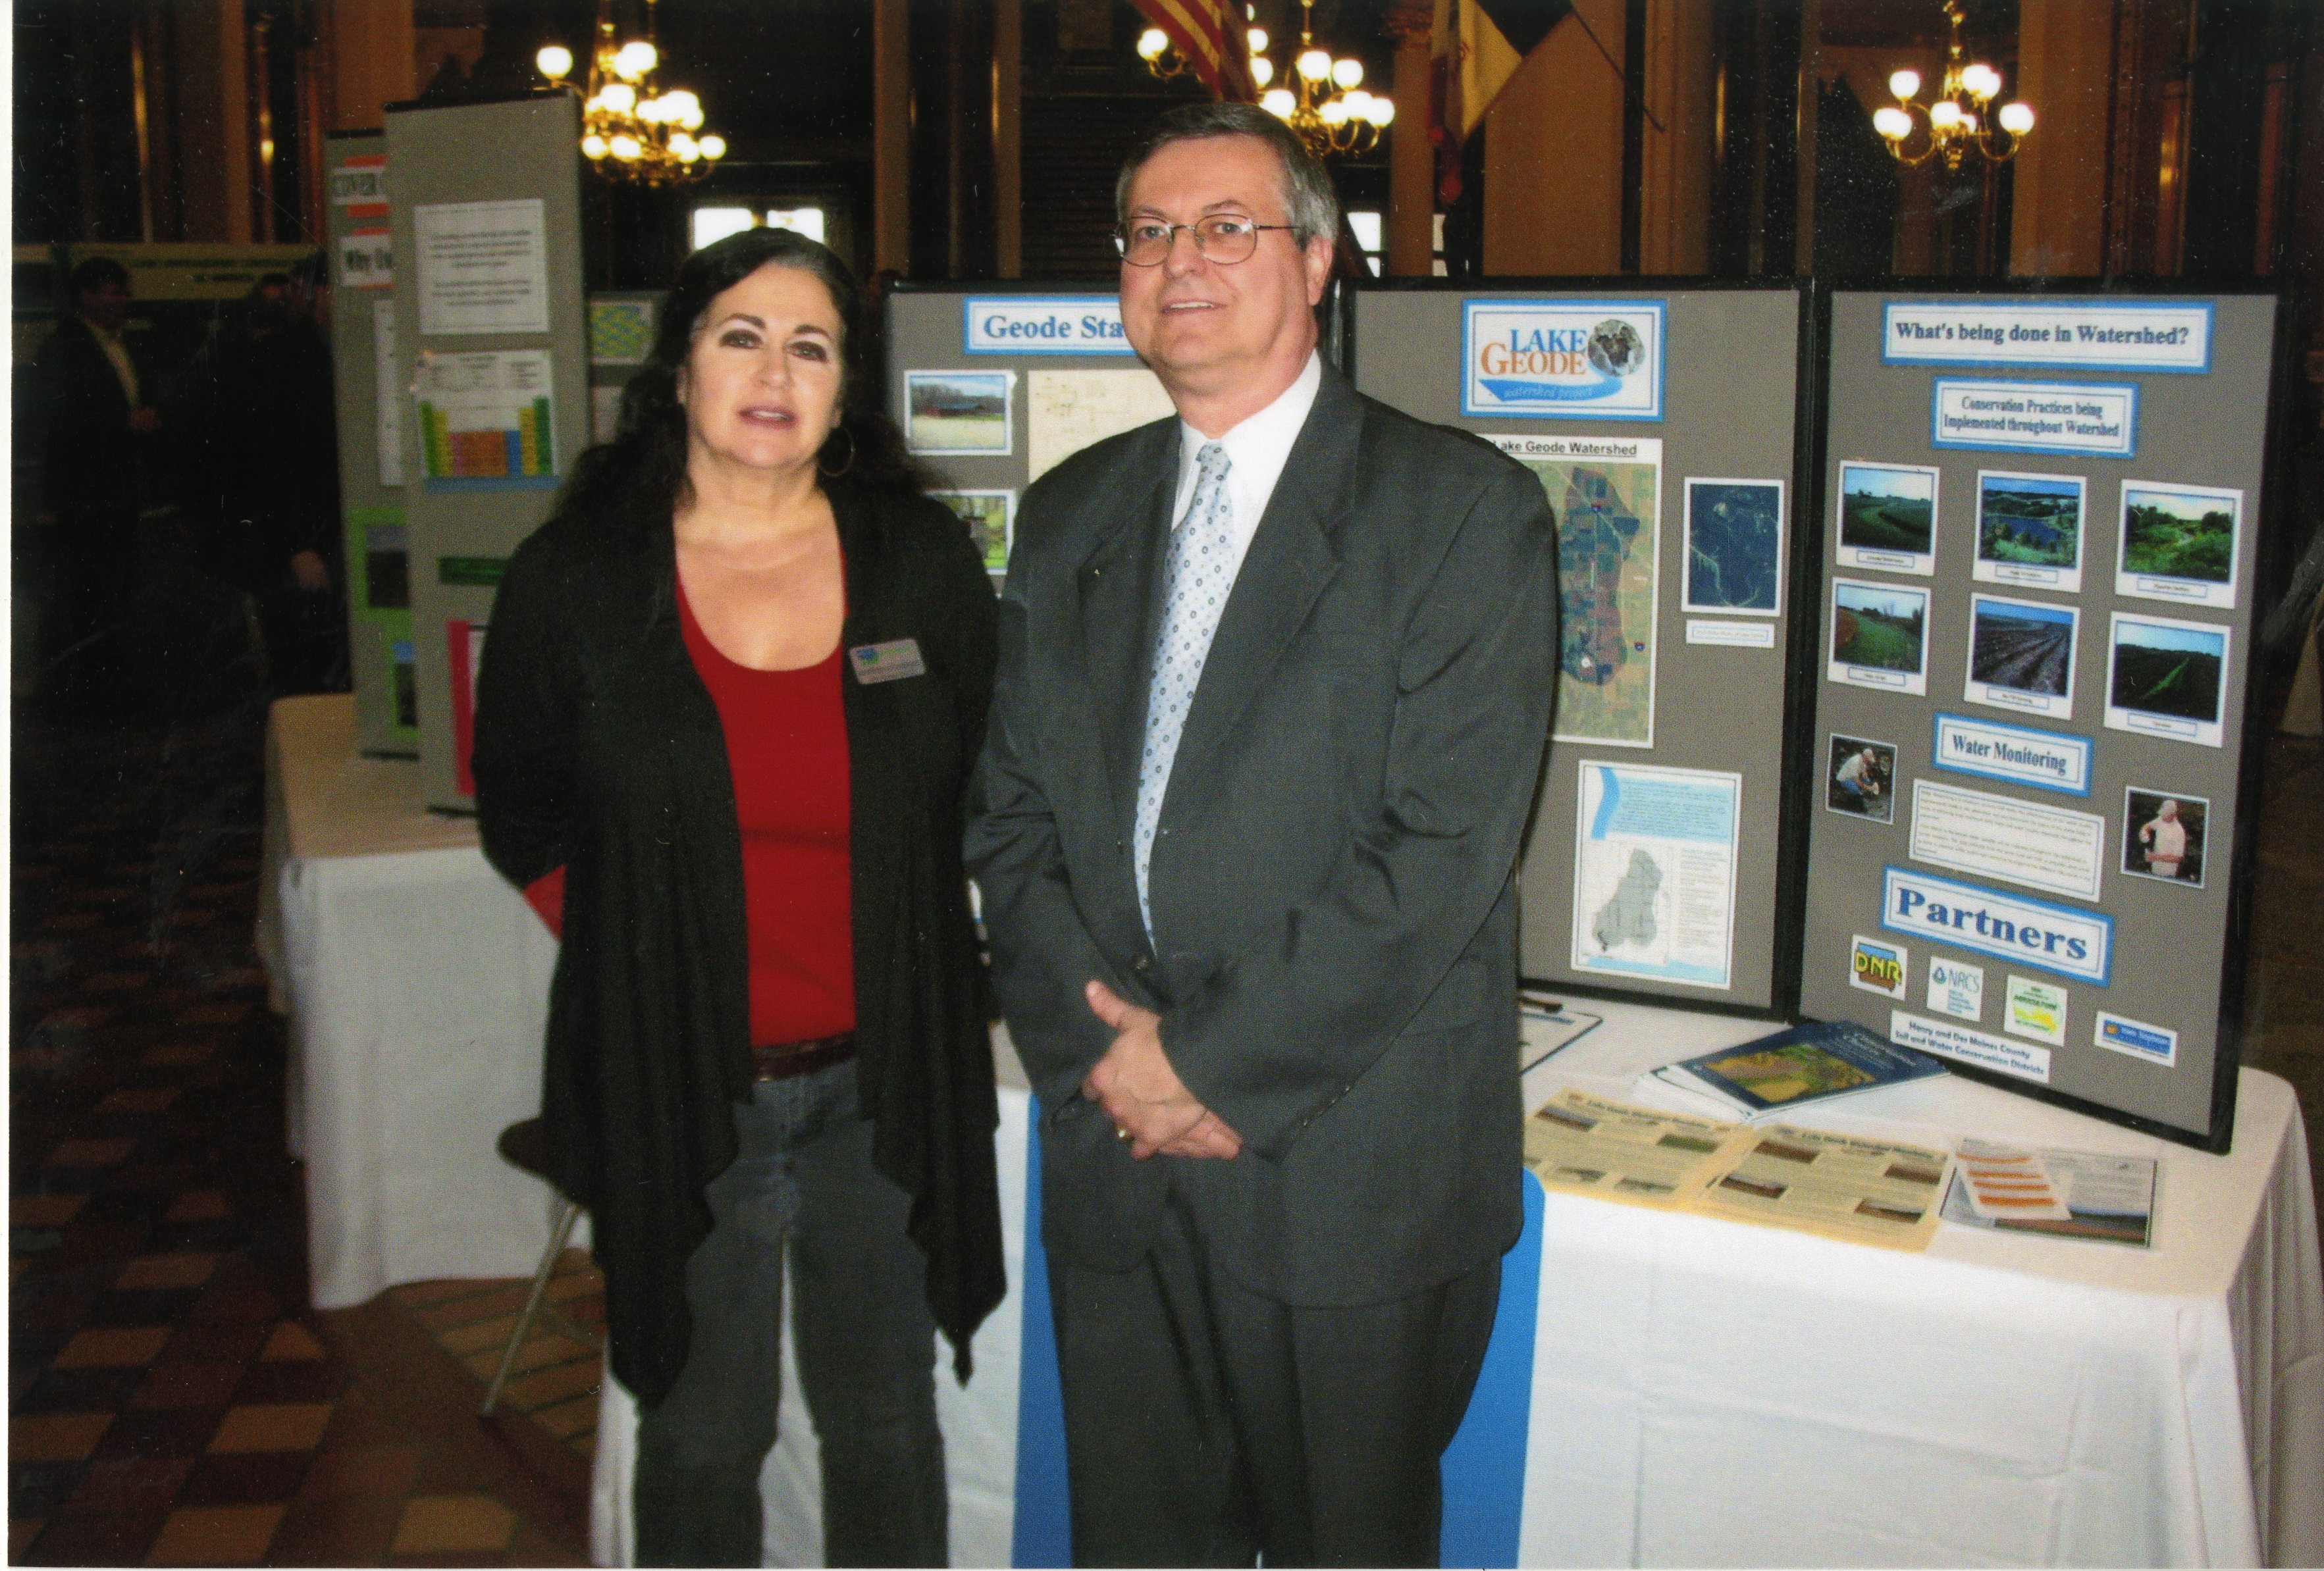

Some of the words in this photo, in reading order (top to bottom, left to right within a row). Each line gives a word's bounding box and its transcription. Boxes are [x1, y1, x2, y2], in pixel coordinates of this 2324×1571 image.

[984, 315, 1071, 338] Geode
[1081, 315, 1123, 338] Sta
[1895, 322, 1954, 340] What's
[1959, 324, 2004, 345] being
[2009, 324, 2050, 342] done
[2055, 325, 2072, 342] in
[2077, 326, 2190, 344] Watershed?
[1510, 328, 1587, 352] LAKE
[1962, 396, 2024, 413] Conservation
[2026, 399, 2073, 414] Practices
[2076, 401, 2103, 420] being
[1944, 414, 2006, 431] Implemented
[2008, 417, 2063, 436] throughout
[2065, 420, 2119, 436] Watershed
[1525, 440, 1566, 453] Geode
[1569, 442, 1637, 455] Watershed
[1953, 734, 1991, 757] Water
[1994, 742, 2067, 775] Monitoring
[1897, 887, 2087, 960] Partners
[1854, 950, 1902, 985] DNR
[1948, 968, 1980, 994] NRCS
[1895, 1029, 1909, 1041] Soil
[1911, 1035, 1926, 1044] and
[1928, 1038, 1953, 1051] Water
[1955, 1044, 2009, 1065] Conservation
[2010, 1059, 2045, 1075] Districts
[1909, 1021, 1935, 1036] Henry
[1935, 1030, 1952, 1039] and
[1953, 1032, 1968, 1043] Des
[1969, 1036, 1997, 1050] Moines
[2000, 1044, 2030, 1060] County
